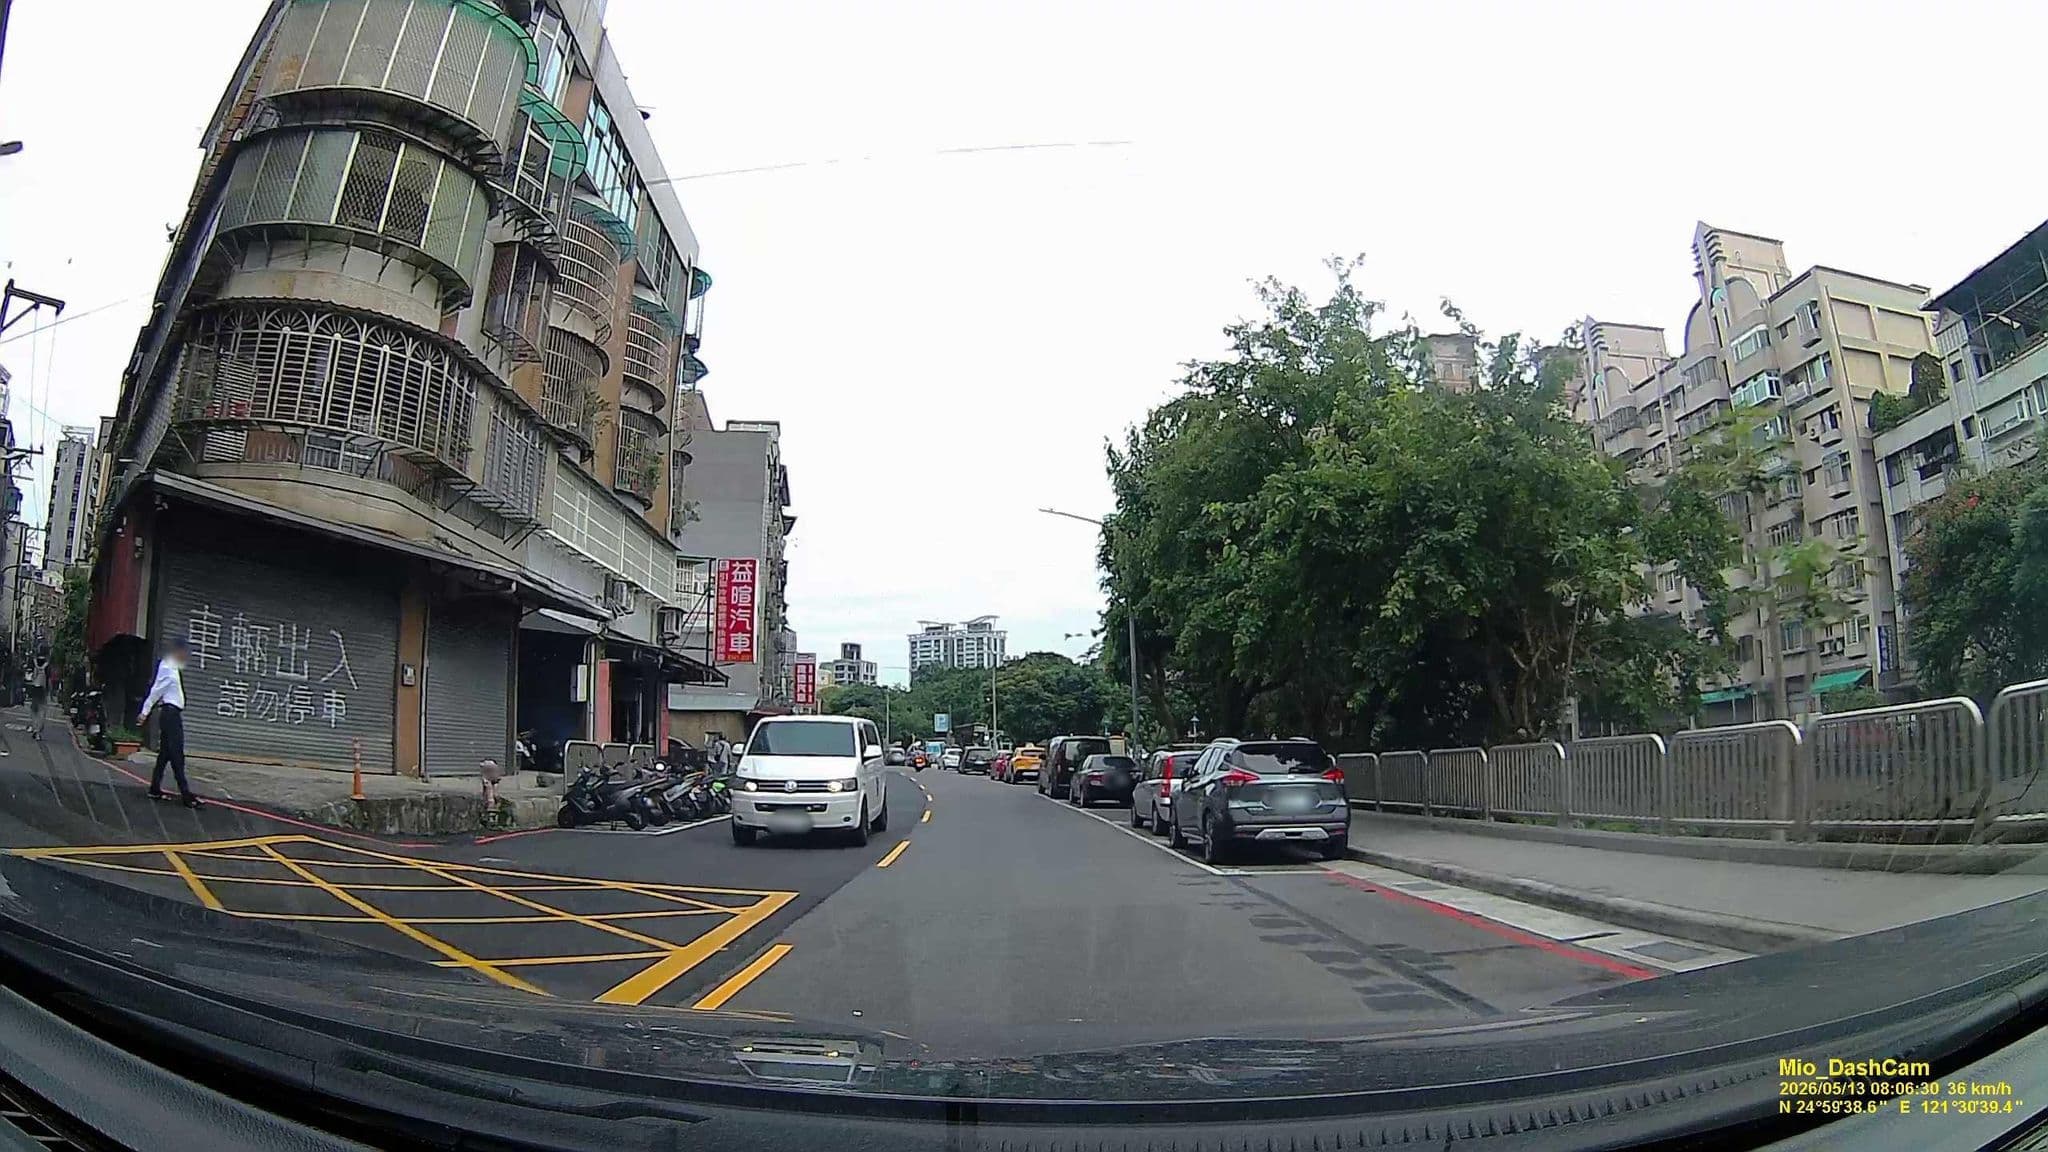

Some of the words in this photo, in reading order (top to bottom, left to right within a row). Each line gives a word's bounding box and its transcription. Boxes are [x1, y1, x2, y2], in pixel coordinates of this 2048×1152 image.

[188, 605, 358, 690] 車輛出入
[729, 561, 753, 655] 益暄汽車
[217, 680, 346, 728] 請勿停車
